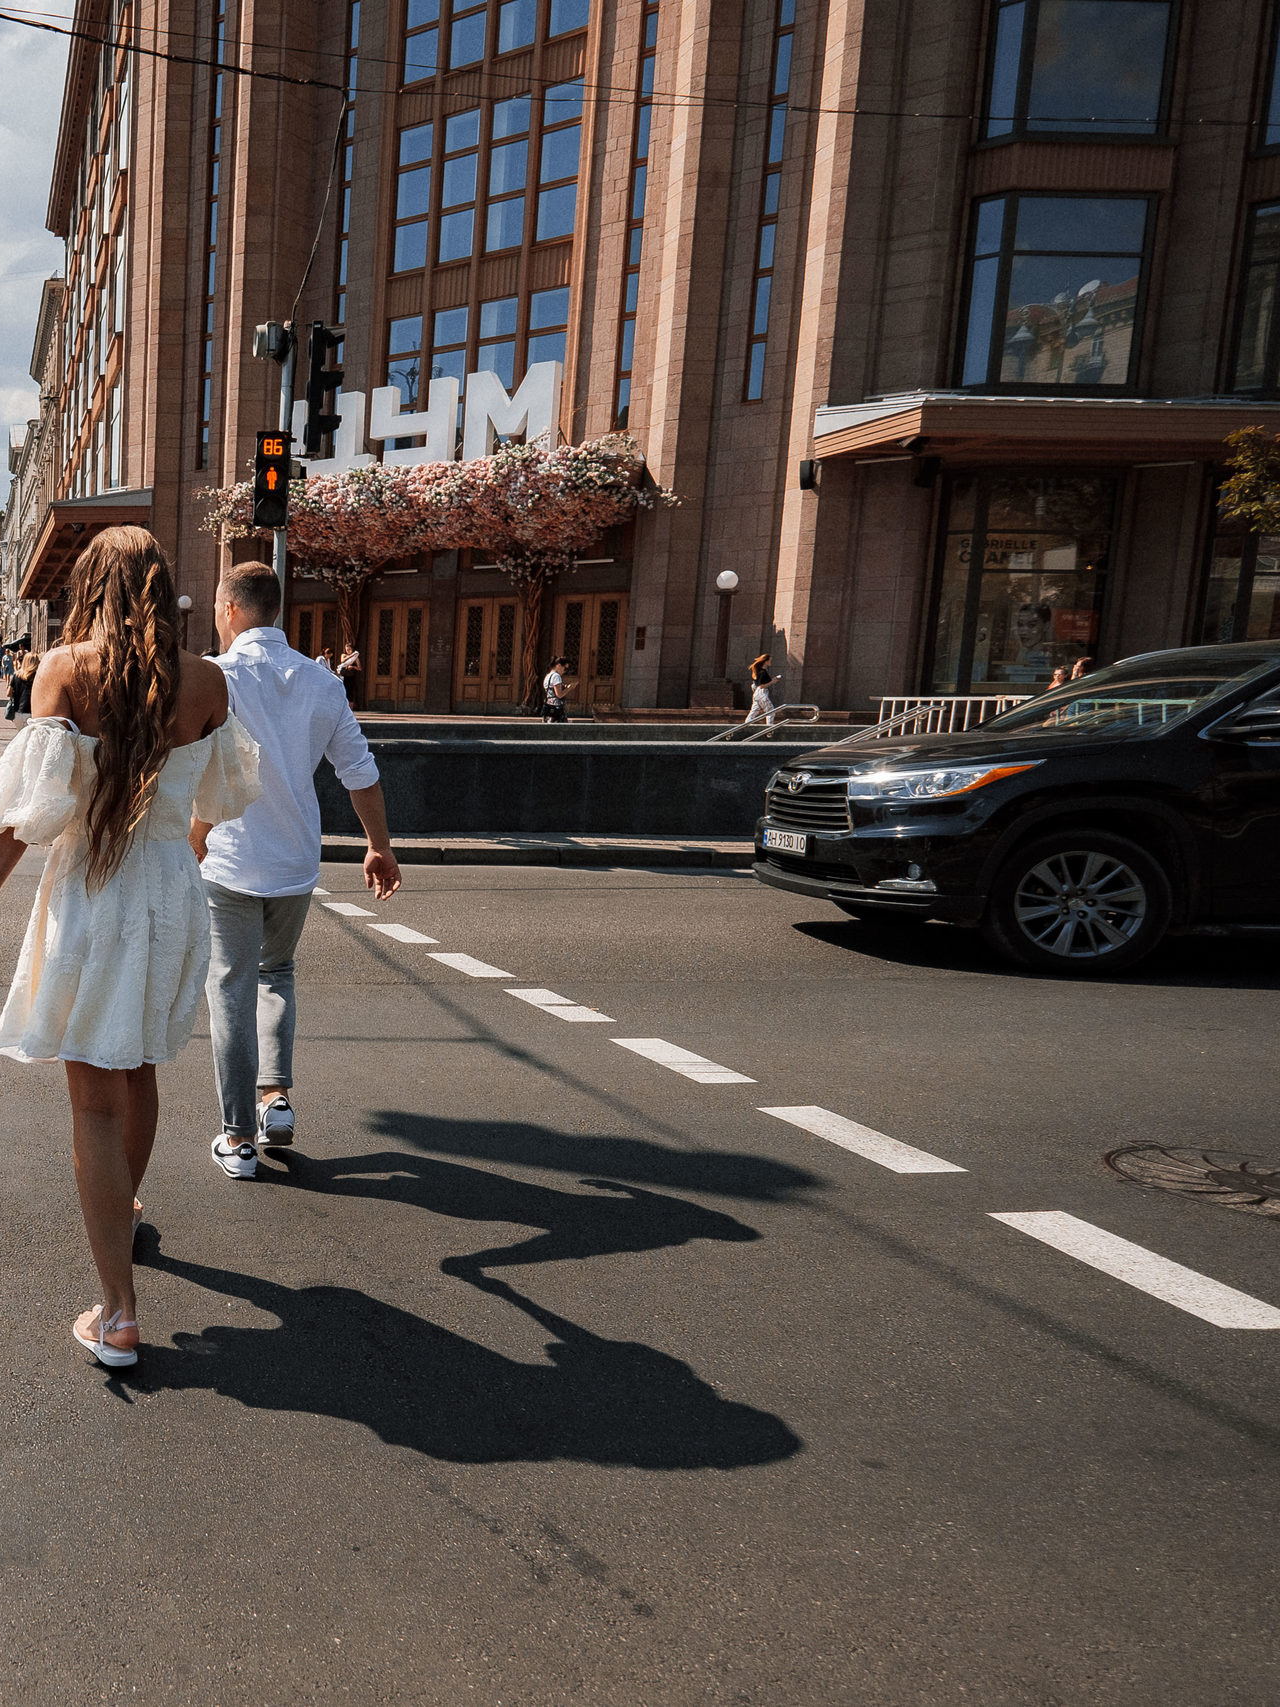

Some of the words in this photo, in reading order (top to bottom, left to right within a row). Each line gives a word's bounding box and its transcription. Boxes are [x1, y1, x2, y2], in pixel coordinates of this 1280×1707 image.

[263, 439, 283, 456] 86
[960, 539, 1038, 550] GBRIELLE
[960, 551, 1035, 564] CANEL
[768, 831, 778, 847] AH
[778, 833, 794, 849] 9130
